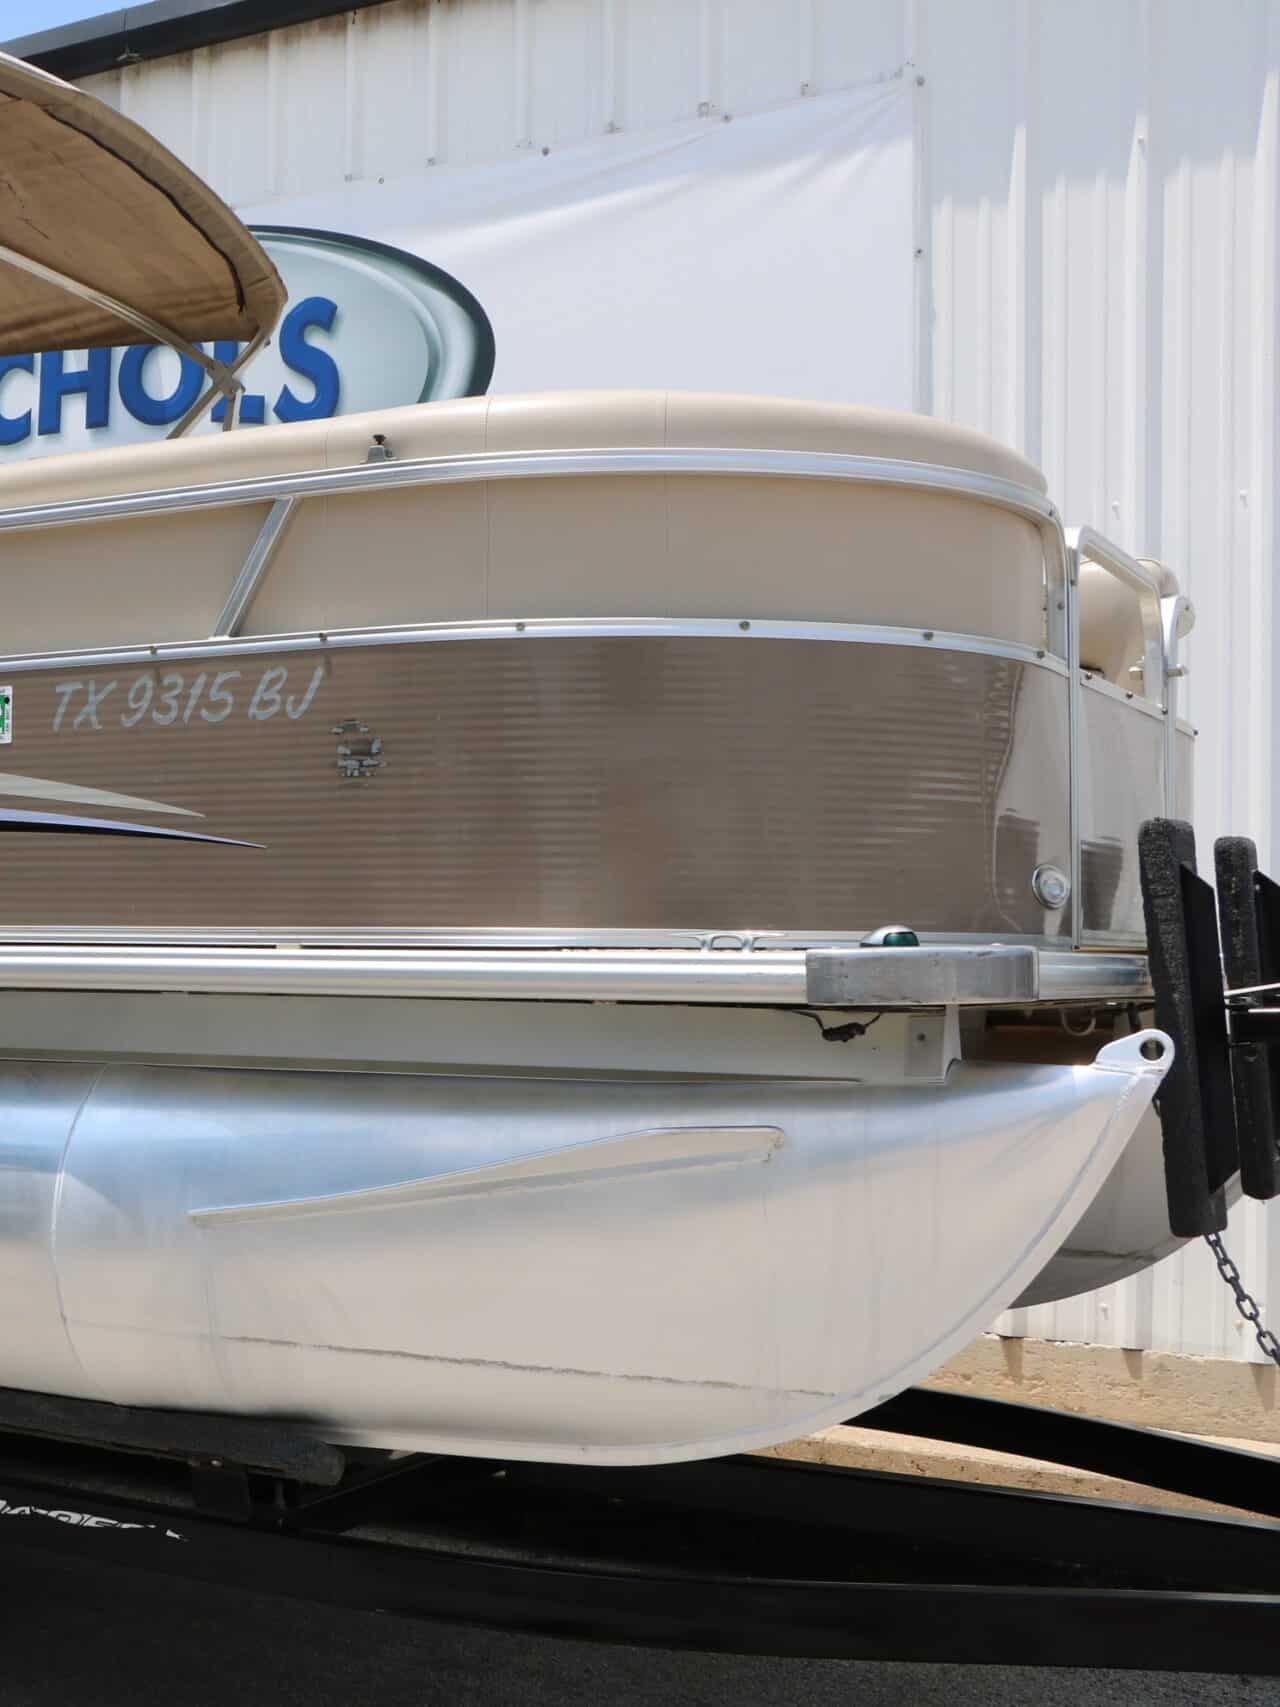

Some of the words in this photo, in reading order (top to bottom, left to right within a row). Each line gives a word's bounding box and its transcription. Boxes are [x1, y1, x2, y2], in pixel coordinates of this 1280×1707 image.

[52, 680, 117, 733] TX
[121, 671, 241, 728] 9315
[247, 665, 322, 720] BJ
